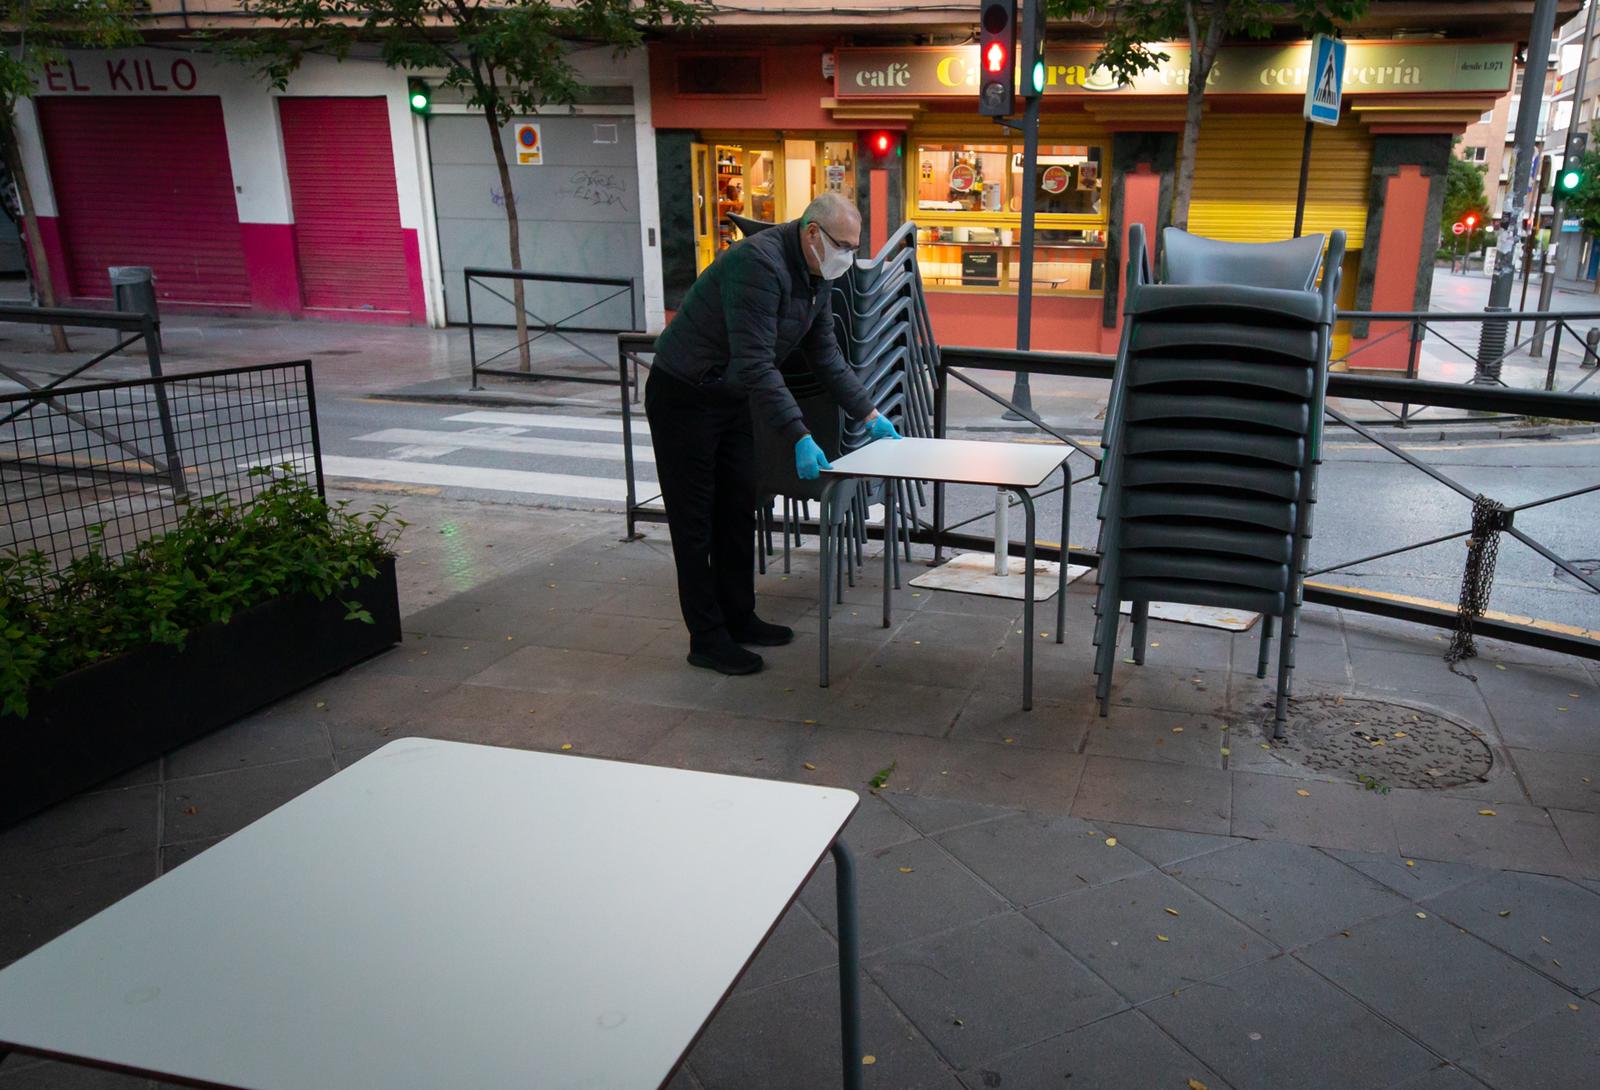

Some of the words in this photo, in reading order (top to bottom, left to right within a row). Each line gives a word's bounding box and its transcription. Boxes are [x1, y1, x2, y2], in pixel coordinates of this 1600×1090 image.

[106, 58, 197, 92] KILO
[855, 62, 911, 87] café
[936, 56, 1086, 87] Cara
[1159, 61, 1221, 85] caé
[1260, 58, 1421, 86] cercería
